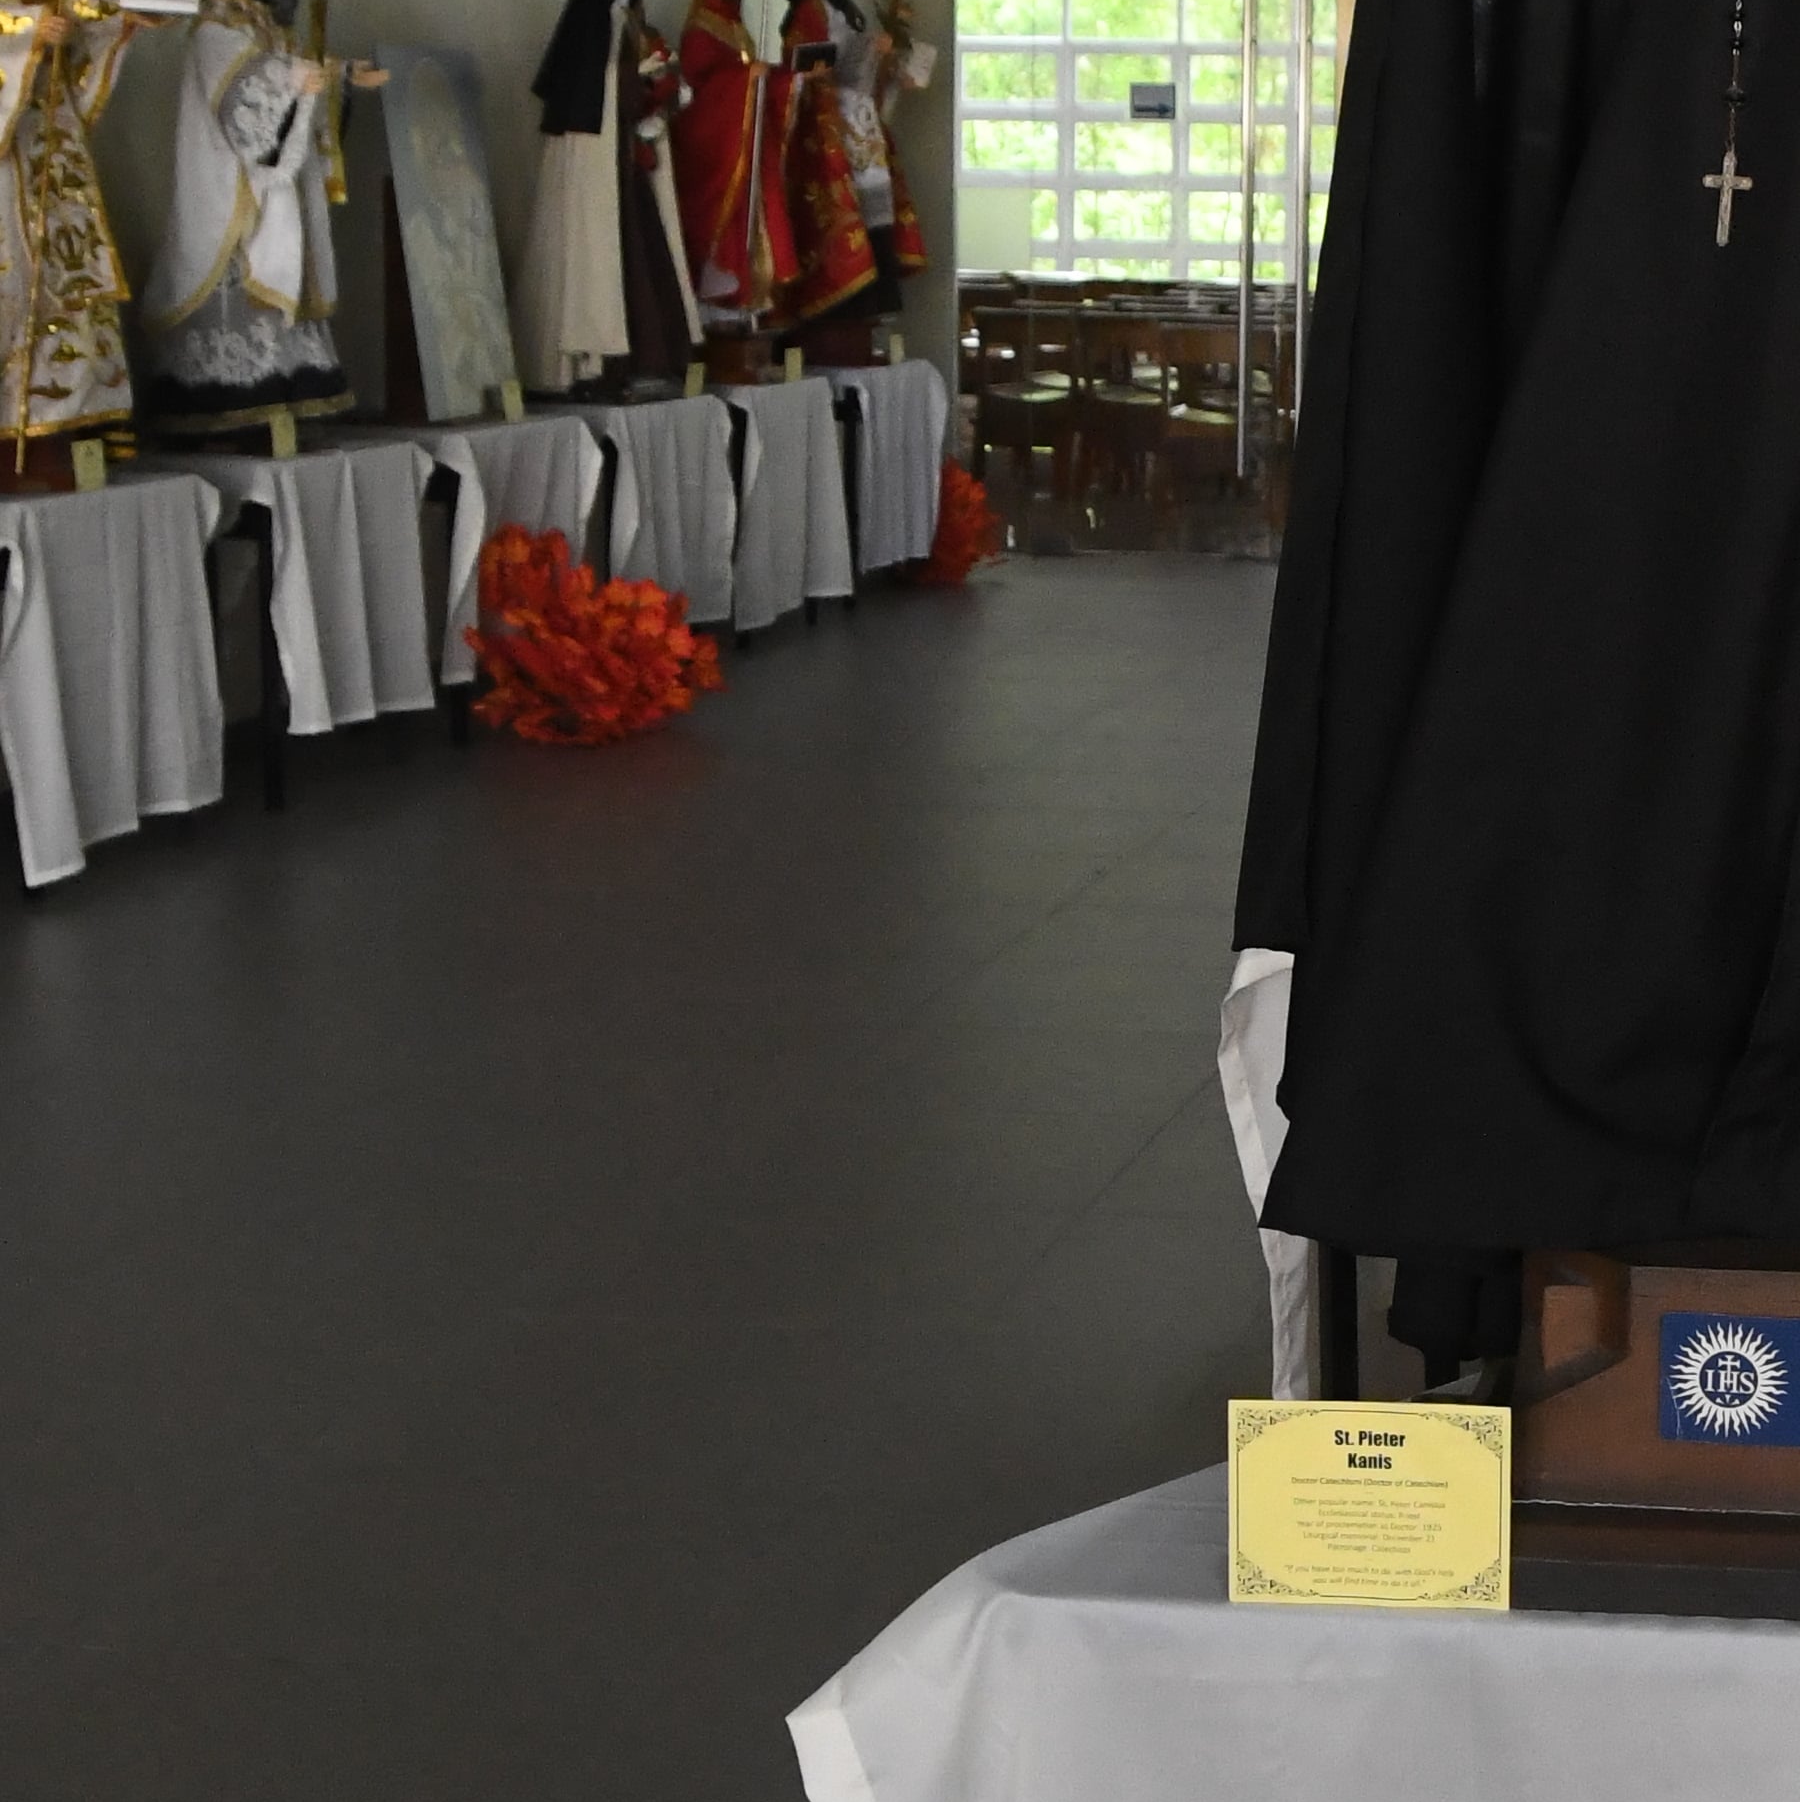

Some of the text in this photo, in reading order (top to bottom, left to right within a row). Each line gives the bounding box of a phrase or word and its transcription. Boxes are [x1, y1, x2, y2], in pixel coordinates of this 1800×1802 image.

[1704, 1368, 1756, 1394] IHS
[1334, 1429, 1406, 1448] St. Pieter
[1347, 1452, 1392, 1470] Kanis
